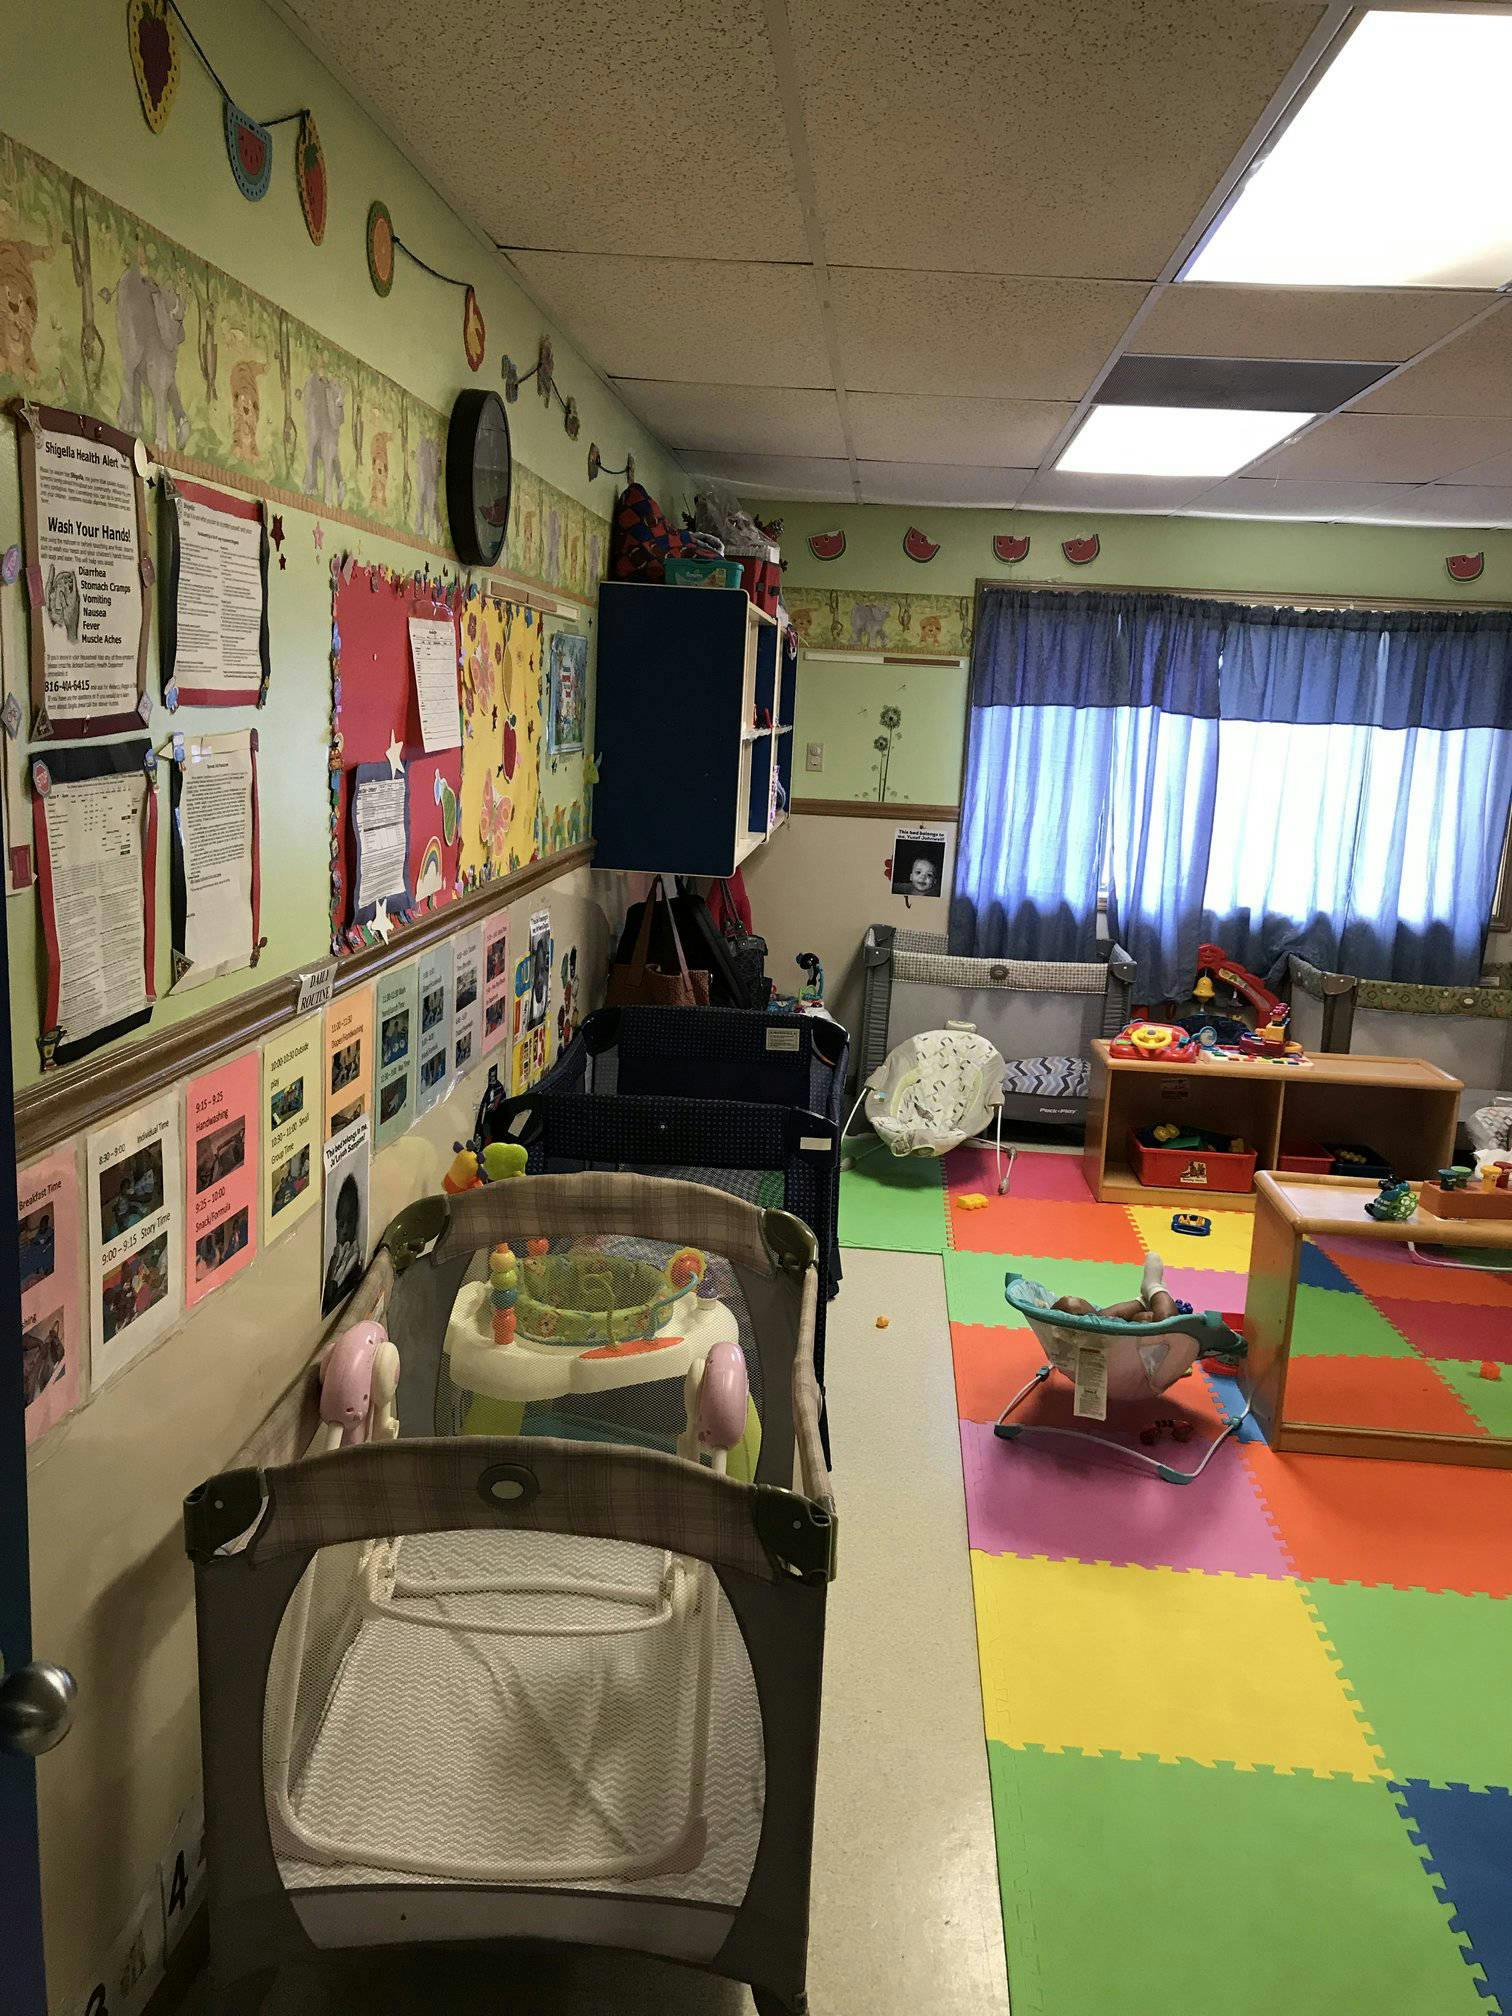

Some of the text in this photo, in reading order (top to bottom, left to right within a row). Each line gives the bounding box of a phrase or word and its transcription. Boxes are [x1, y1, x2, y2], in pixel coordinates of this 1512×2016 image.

[45, 441, 118, 468] Shigella Health Alert
[48, 516, 131, 542] Wash Your Hands!
[78, 566, 106, 578] Diarrhea
[81, 580, 130, 594] Stomach Cramps
[83, 594, 112, 606] Vomiting
[84, 608, 106, 617] Nausea
[83, 621, 100, 630] Fever
[82, 634, 122, 644] Muscle Aches
[310, 969, 330, 988] DAILY
[301, 986, 330, 1010] ROUTINE
[137, 1120, 169, 1144] Individual Time
[196, 1108, 229, 1133] Handwashing
[271, 1142, 294, 1164] Group Time
[19, 1180, 62, 1211] Breakfast Time
[196, 1203, 231, 1233] Snack/Formula
[102, 1247, 117, 1266] 9:00
[122, 1234, 137, 1252] 9:15
[141, 1224, 156, 1240] Story
[157, 1212, 171, 1228] Time
[167, 1850, 188, 1917] 4
